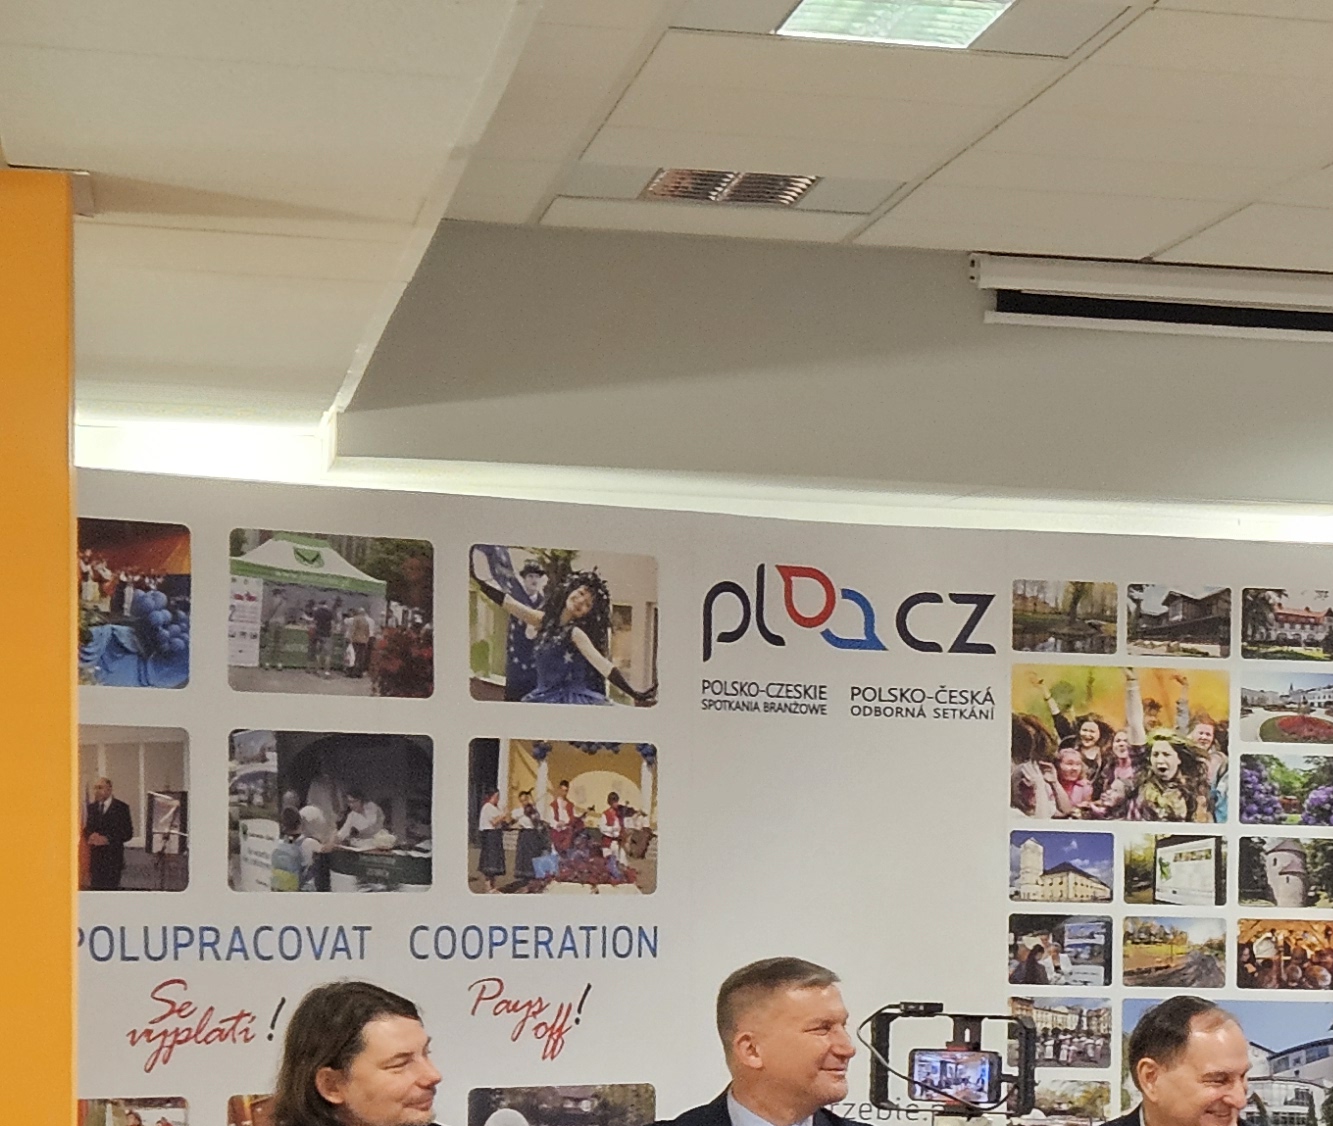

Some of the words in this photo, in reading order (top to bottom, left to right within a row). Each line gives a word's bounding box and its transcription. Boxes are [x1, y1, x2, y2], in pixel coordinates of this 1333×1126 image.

[701, 679, 828, 701] POLSKO-CZESKIE
[849, 685, 996, 706] POLSKO-ČESKÁ
[701, 698, 761, 713] SPOTKANIA
[763, 701, 828, 716] BRANŻOWE
[850, 704, 927, 719] ODBORNÁ
[933, 706, 995, 721] SETKÁNÍ
[77, 925, 373, 961] OLUPRACOVAT
[409, 924, 659, 960] COOPERATION
[149, 978, 198, 1024] Se
[467, 977, 551, 1042] Pays
